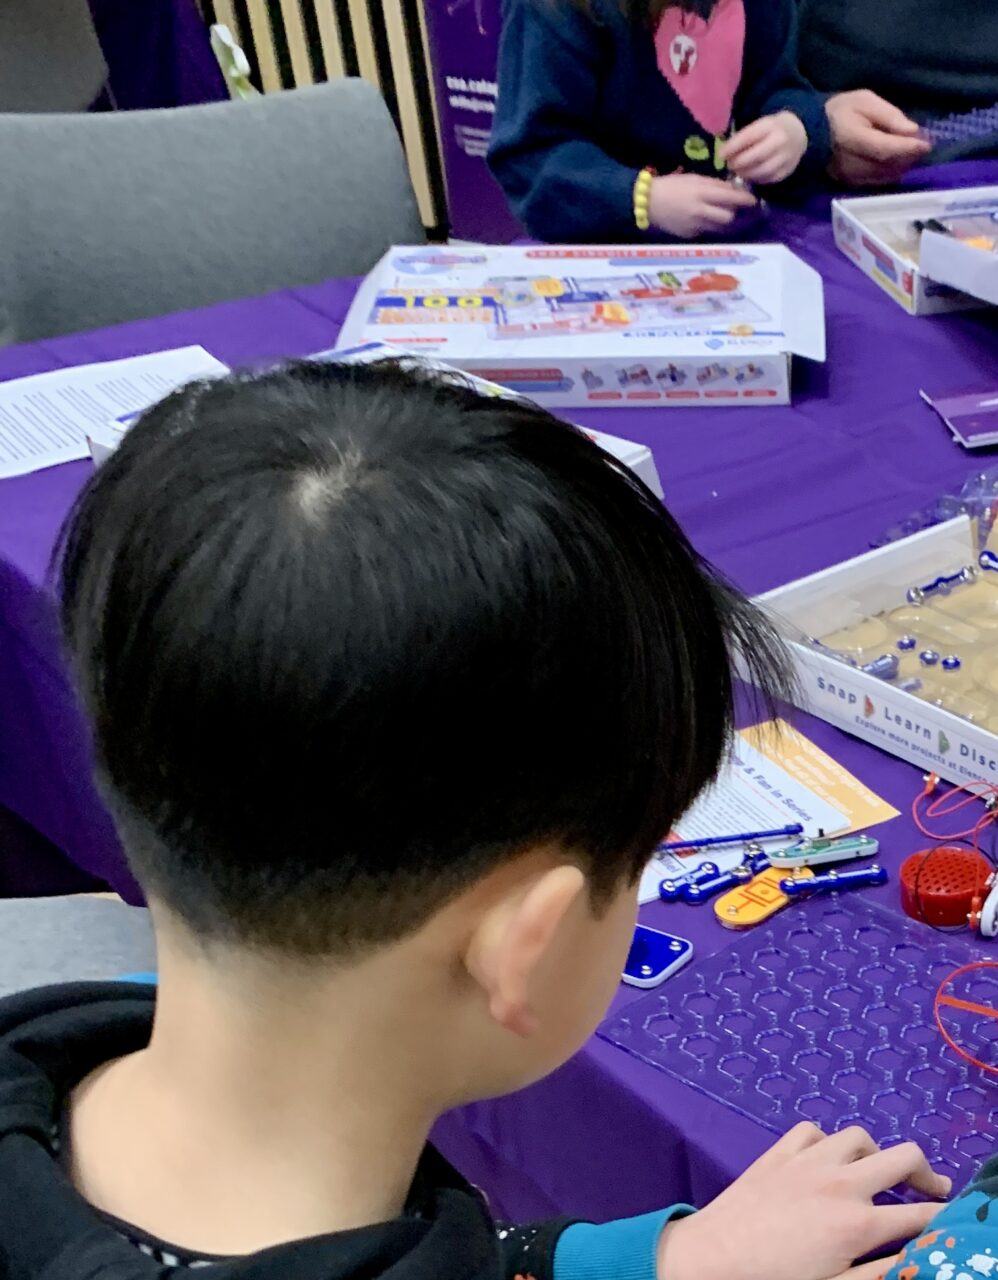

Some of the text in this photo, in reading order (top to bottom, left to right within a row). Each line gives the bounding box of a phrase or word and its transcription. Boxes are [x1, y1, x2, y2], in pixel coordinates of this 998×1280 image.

[816, 676, 858, 705] Snap
[884, 706, 933, 741] Learn
[753, 774, 773, 790] Fan
[770, 789, 783, 800] in
[782, 796, 814, 823] Series
